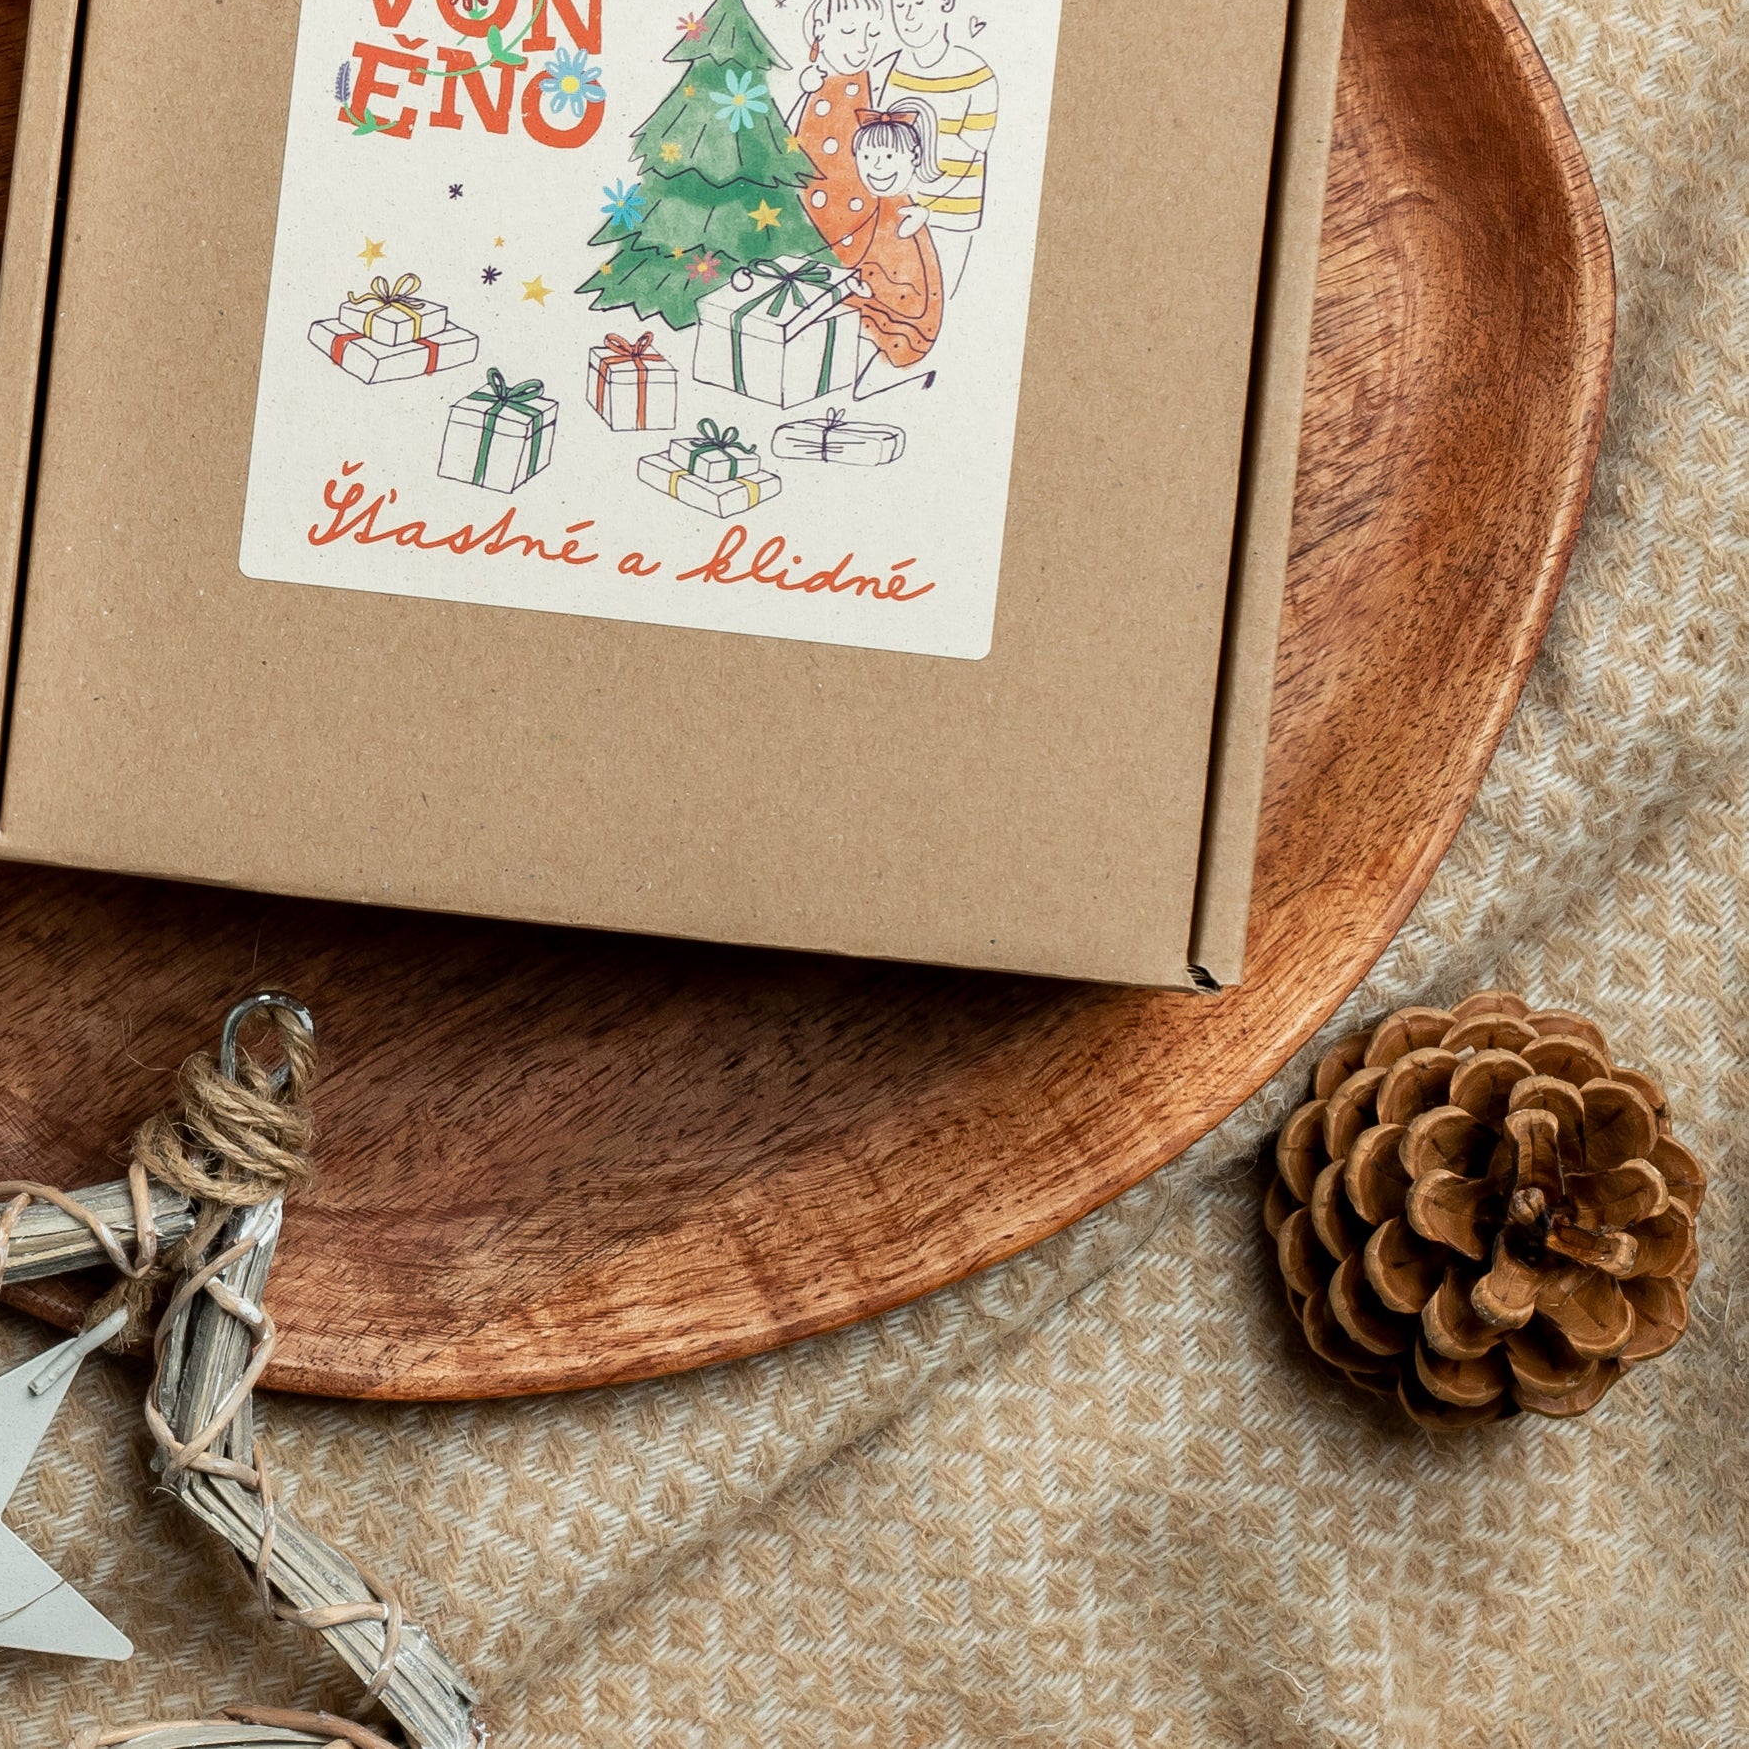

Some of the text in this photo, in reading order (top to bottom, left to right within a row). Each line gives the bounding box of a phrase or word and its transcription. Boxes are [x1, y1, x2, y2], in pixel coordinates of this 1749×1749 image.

[337, 34, 607, 149] ĚNO
[308, 460, 938, 602] Šťastné a klidné
